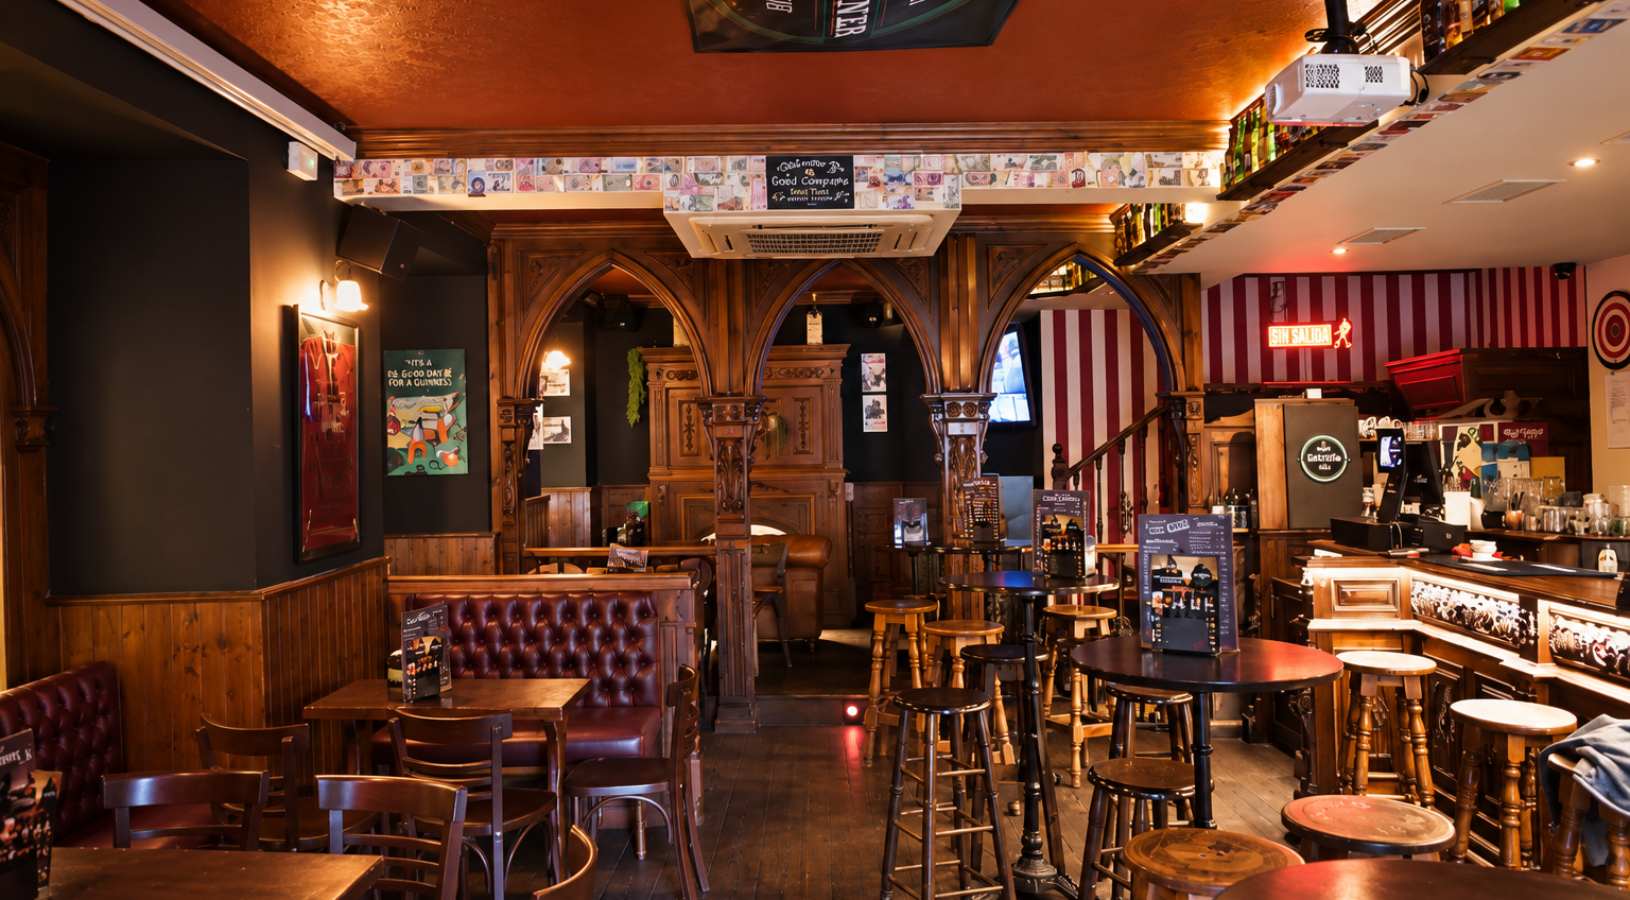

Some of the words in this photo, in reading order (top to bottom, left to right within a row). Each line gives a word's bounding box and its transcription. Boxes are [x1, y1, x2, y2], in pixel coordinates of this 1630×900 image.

[1272, 328, 1289, 345] SIN
[1291, 327, 1329, 344] SALIDA
[388, 378, 404, 387] FOR
[406, 379, 413, 387] A
